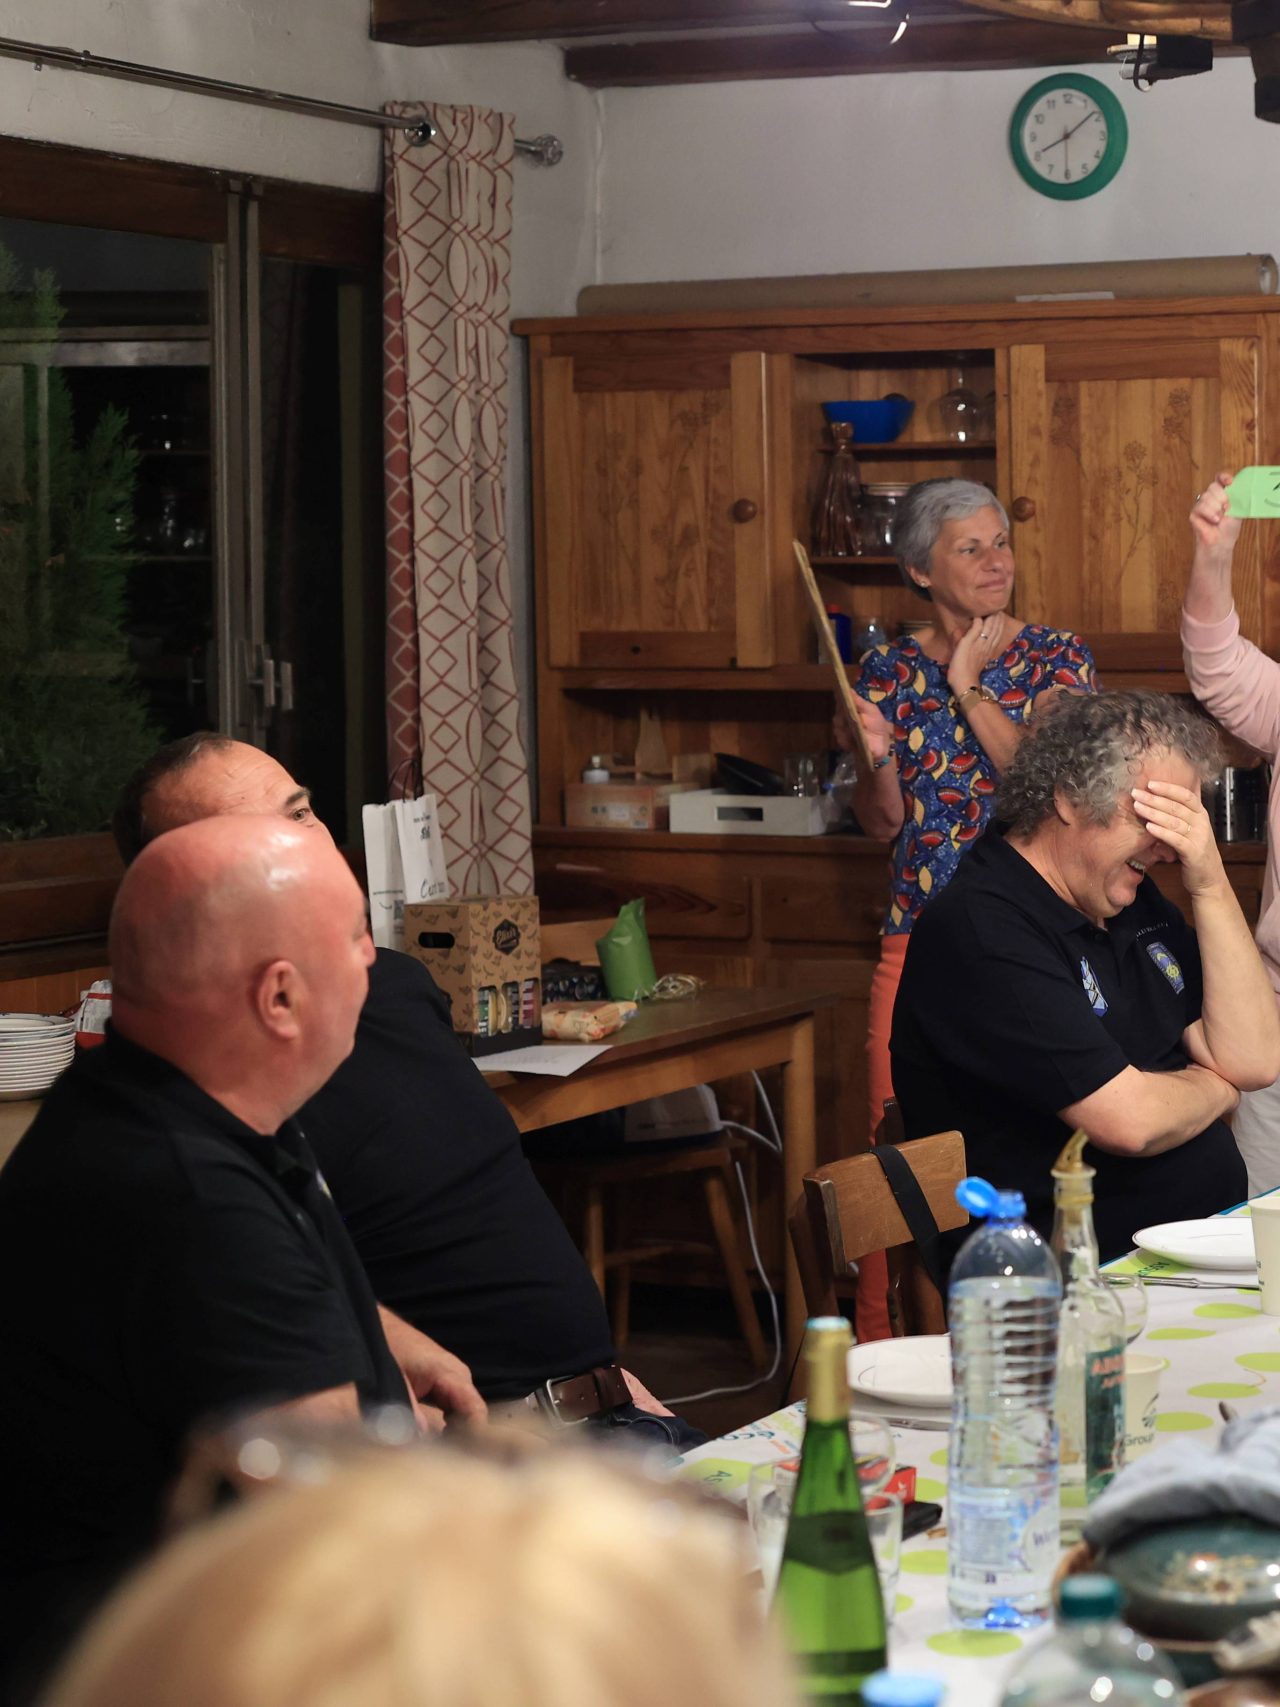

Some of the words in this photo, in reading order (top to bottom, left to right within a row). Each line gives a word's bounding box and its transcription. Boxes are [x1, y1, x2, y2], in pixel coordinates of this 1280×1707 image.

[1062, 93, 1073, 104] 12
[1046, 100, 1056, 109] 11
[1034, 114, 1046, 125] 10
